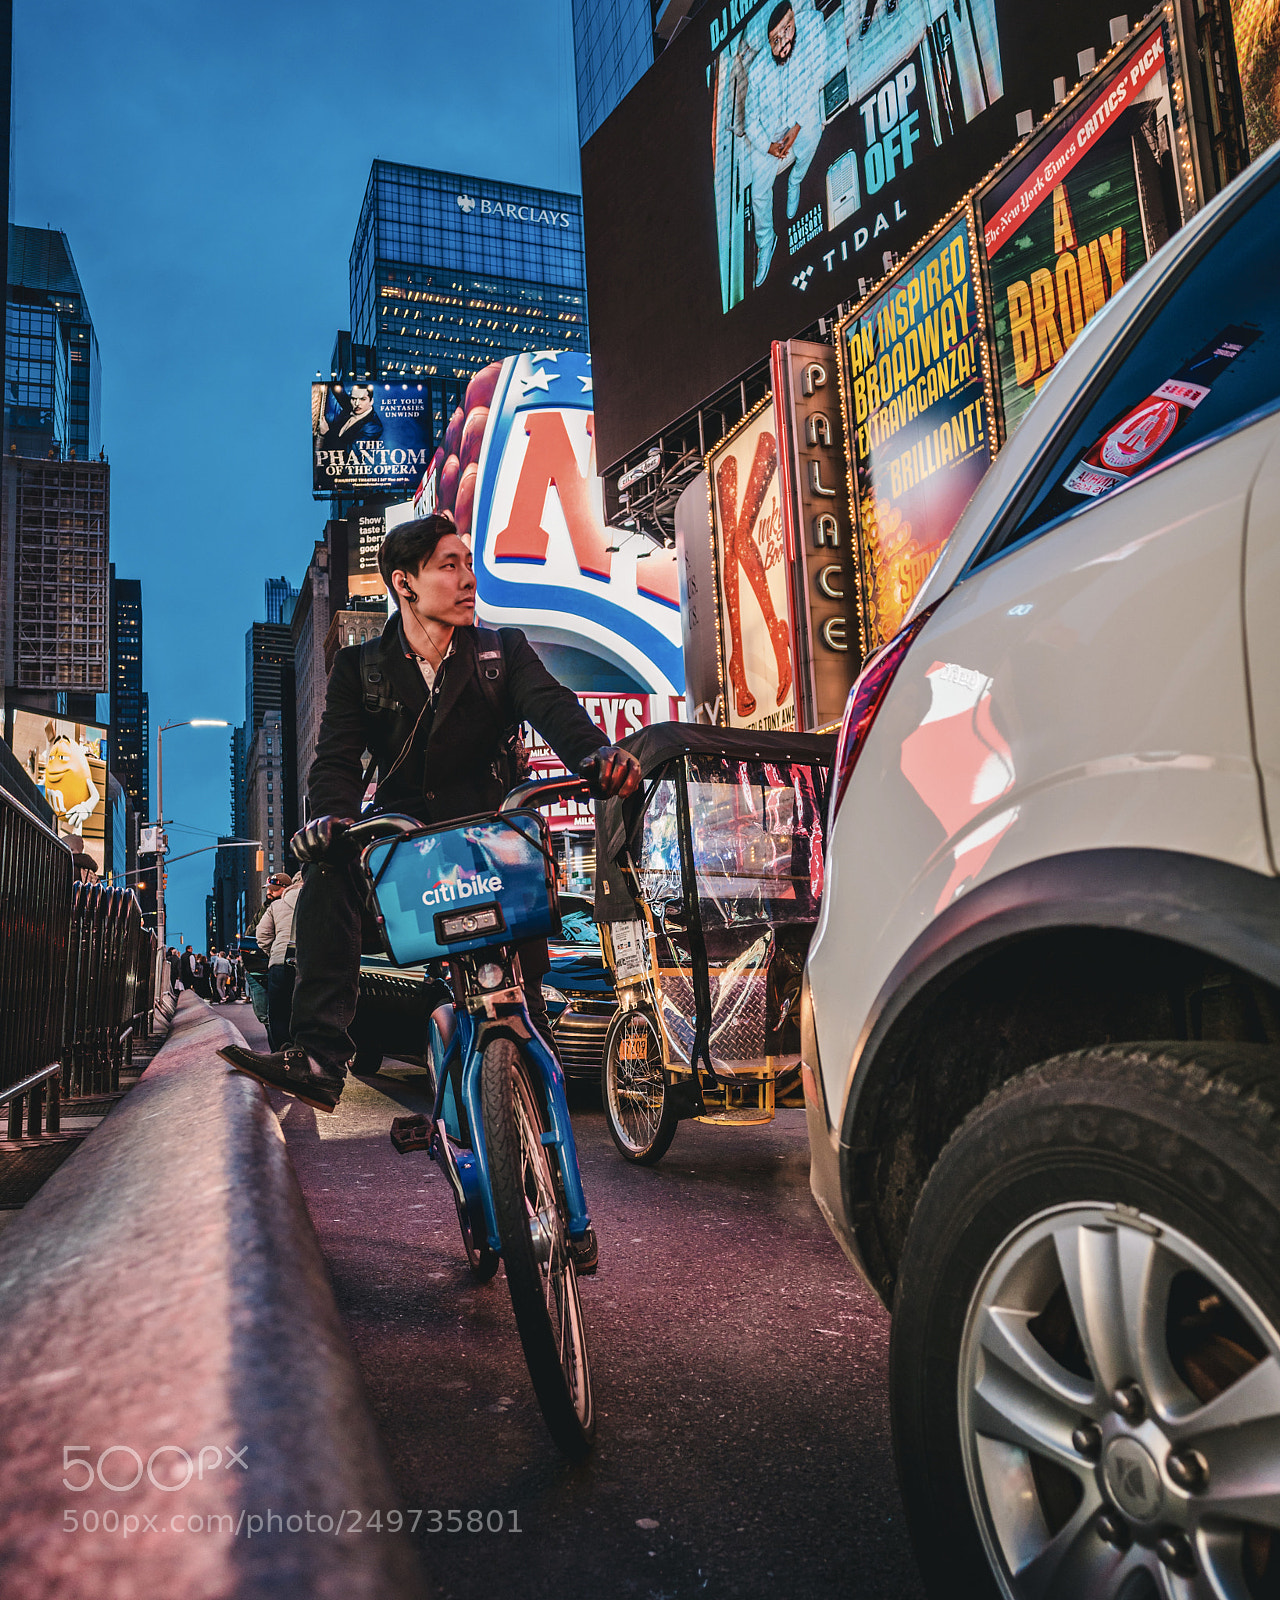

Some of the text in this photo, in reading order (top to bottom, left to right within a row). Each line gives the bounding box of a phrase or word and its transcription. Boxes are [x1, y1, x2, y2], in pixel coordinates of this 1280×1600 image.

[709, 6, 729, 52] DJ
[859, 62, 917, 147] TOP
[864, 109, 921, 195] OFF
[985, 228, 1001, 247] The
[1000, 208, 1021, 230] New
[1020, 177, 1045, 214] York
[1044, 142, 1077, 183] Times
[1129, 36, 1164, 87] PICK
[480, 199, 570, 228] BARCLAYS
[788, 203, 822, 236] PARENTAL
[789, 211, 823, 248] ADVISORY
[1052, 181, 1078, 255] A
[823, 199, 907, 272] TIDAL
[877, 235, 967, 353] INSPIRED
[853, 281, 969, 425] BROADWAY
[315, 448, 427, 467] PHANTOM
[356, 440, 385, 450] THE
[325, 464, 418, 476] OF THE OPERA
[359, 516, 382, 526] Show
[801, 361, 848, 651] PALACE
[359, 526, 381, 535] taste
[359, 543, 380, 555] good
[763, 711, 780, 731] TONY
[530, 748, 549, 758] MILK
[574, 817, 595, 826] MILK
[422, 874, 503, 906] citi bike
